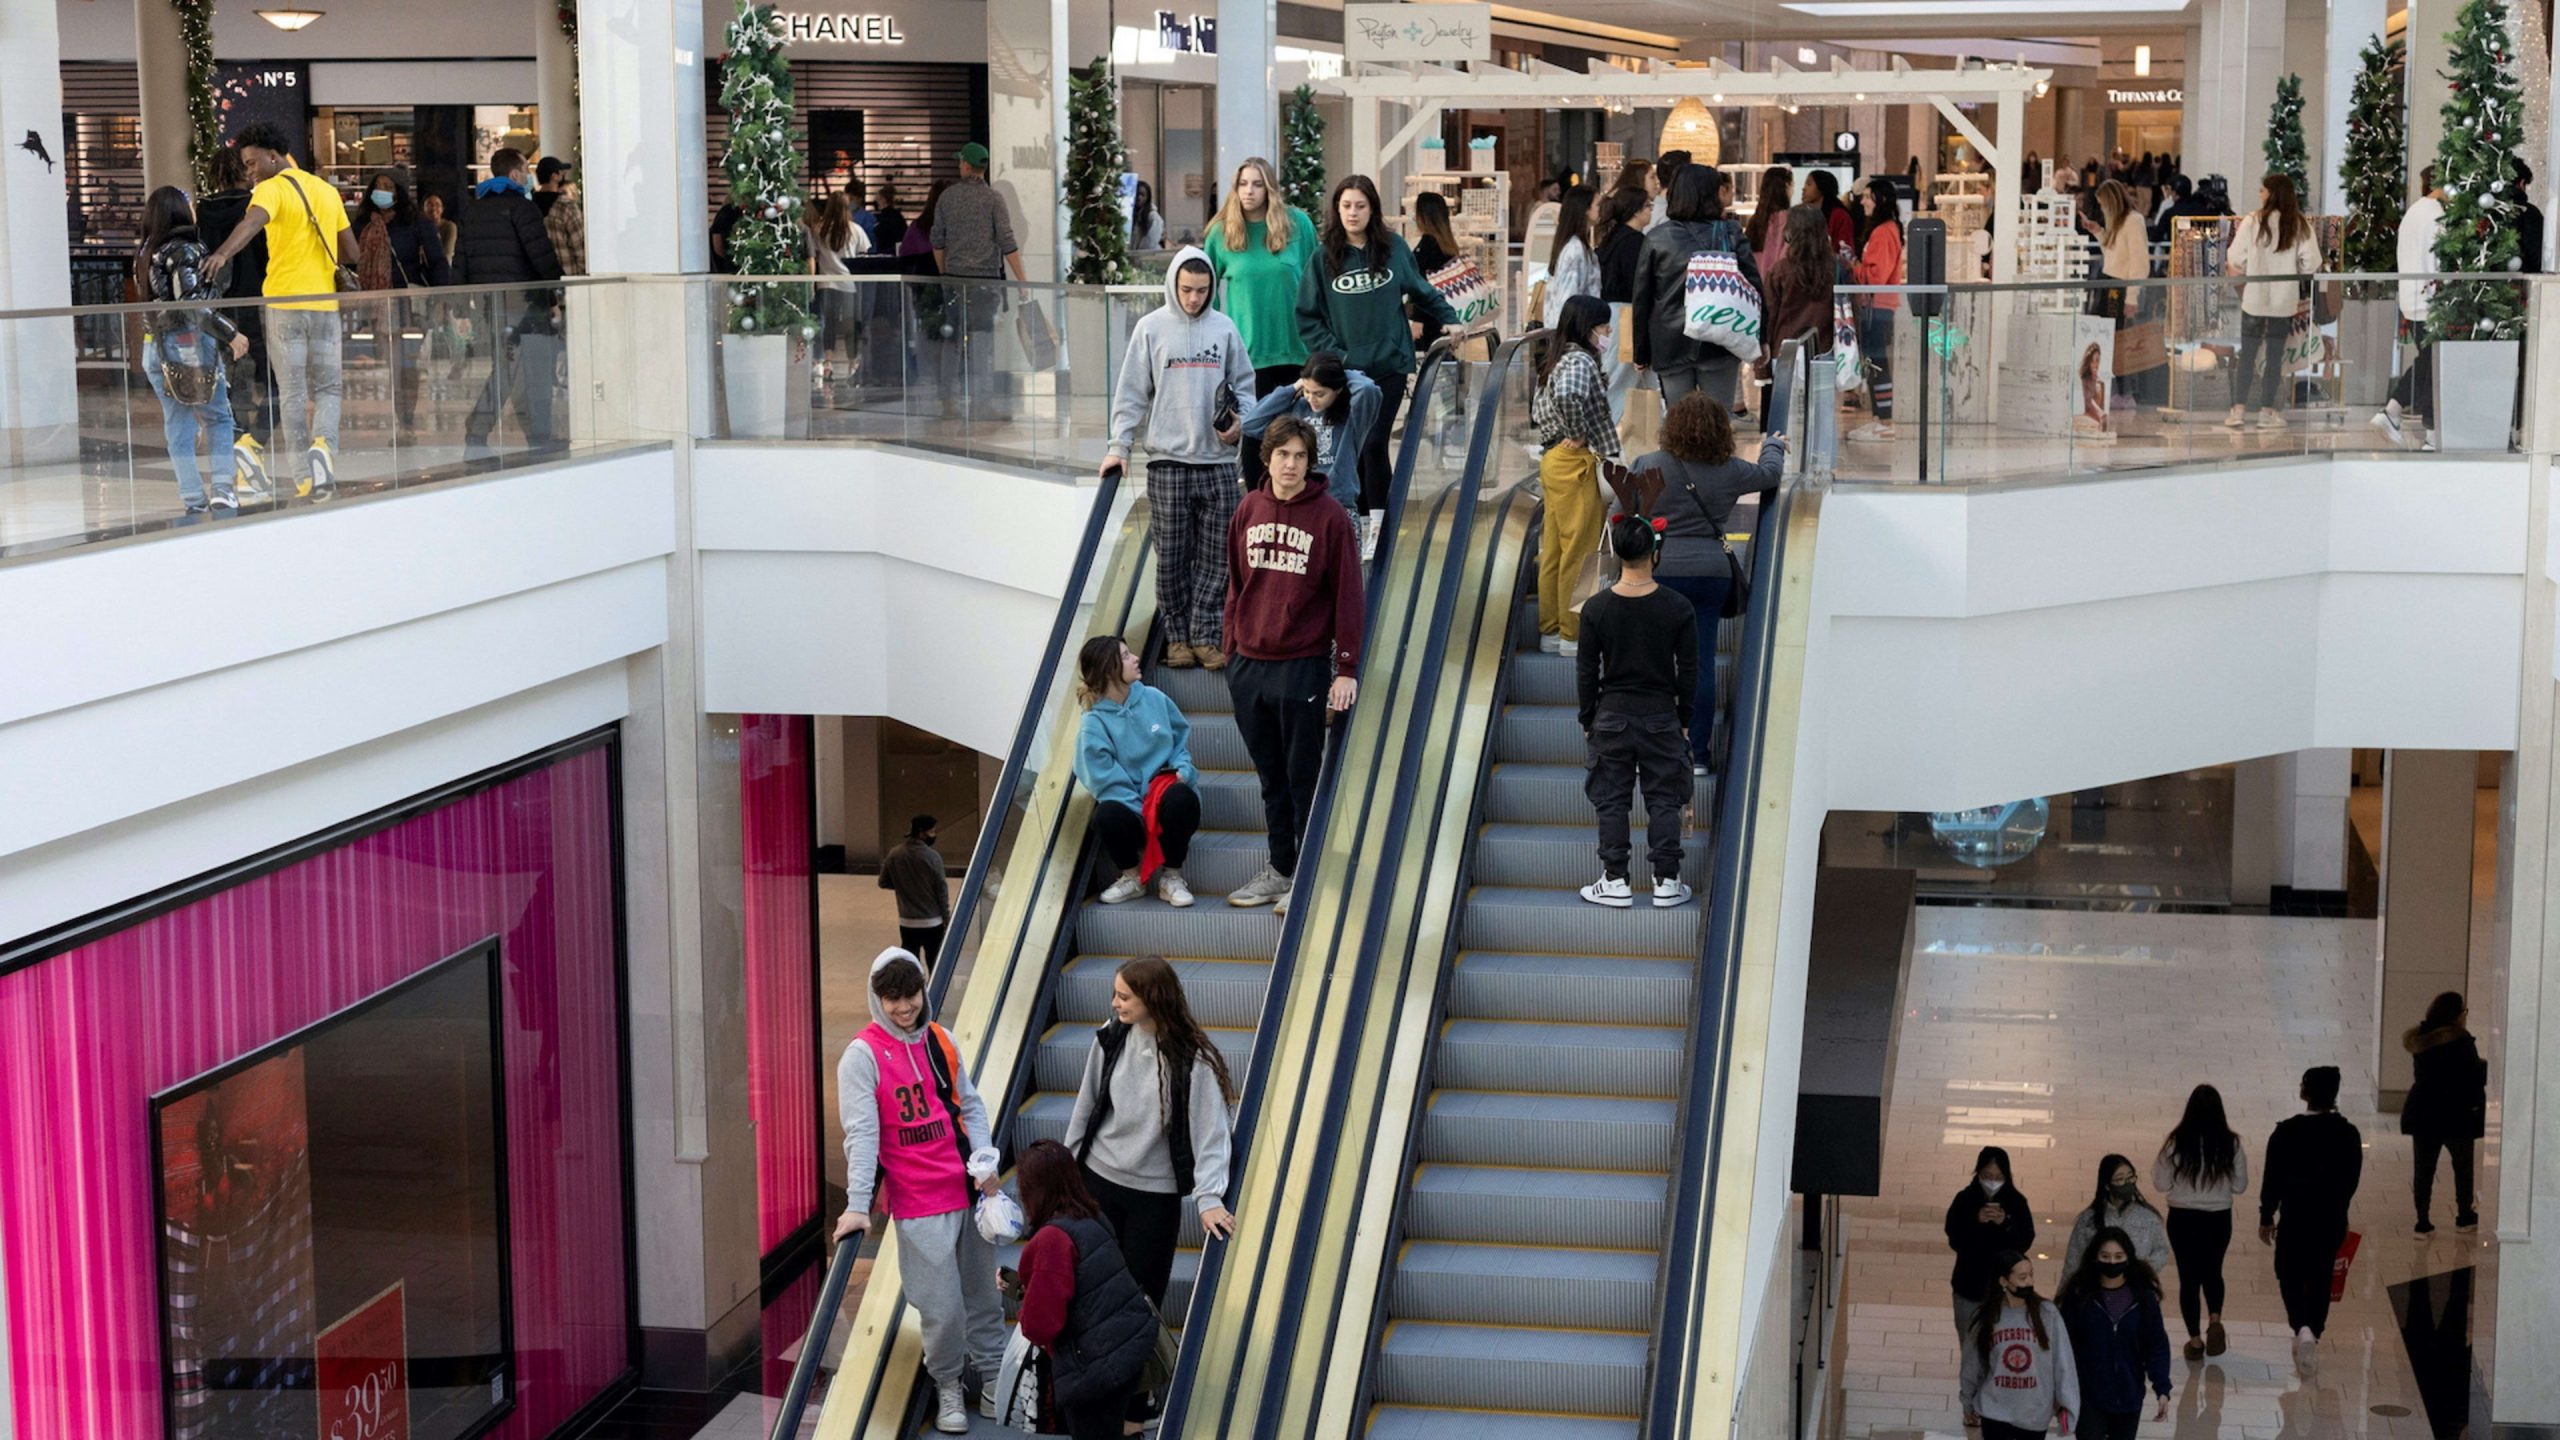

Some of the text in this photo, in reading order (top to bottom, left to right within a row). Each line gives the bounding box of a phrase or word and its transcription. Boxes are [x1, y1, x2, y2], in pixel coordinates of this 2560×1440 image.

[1420, 17, 1480, 49] Jewelry
[1246, 522, 1314, 555] BOSTON
[895, 1082, 930, 1123] 33
[1993, 1375, 2038, 1389] VIRGINIA
